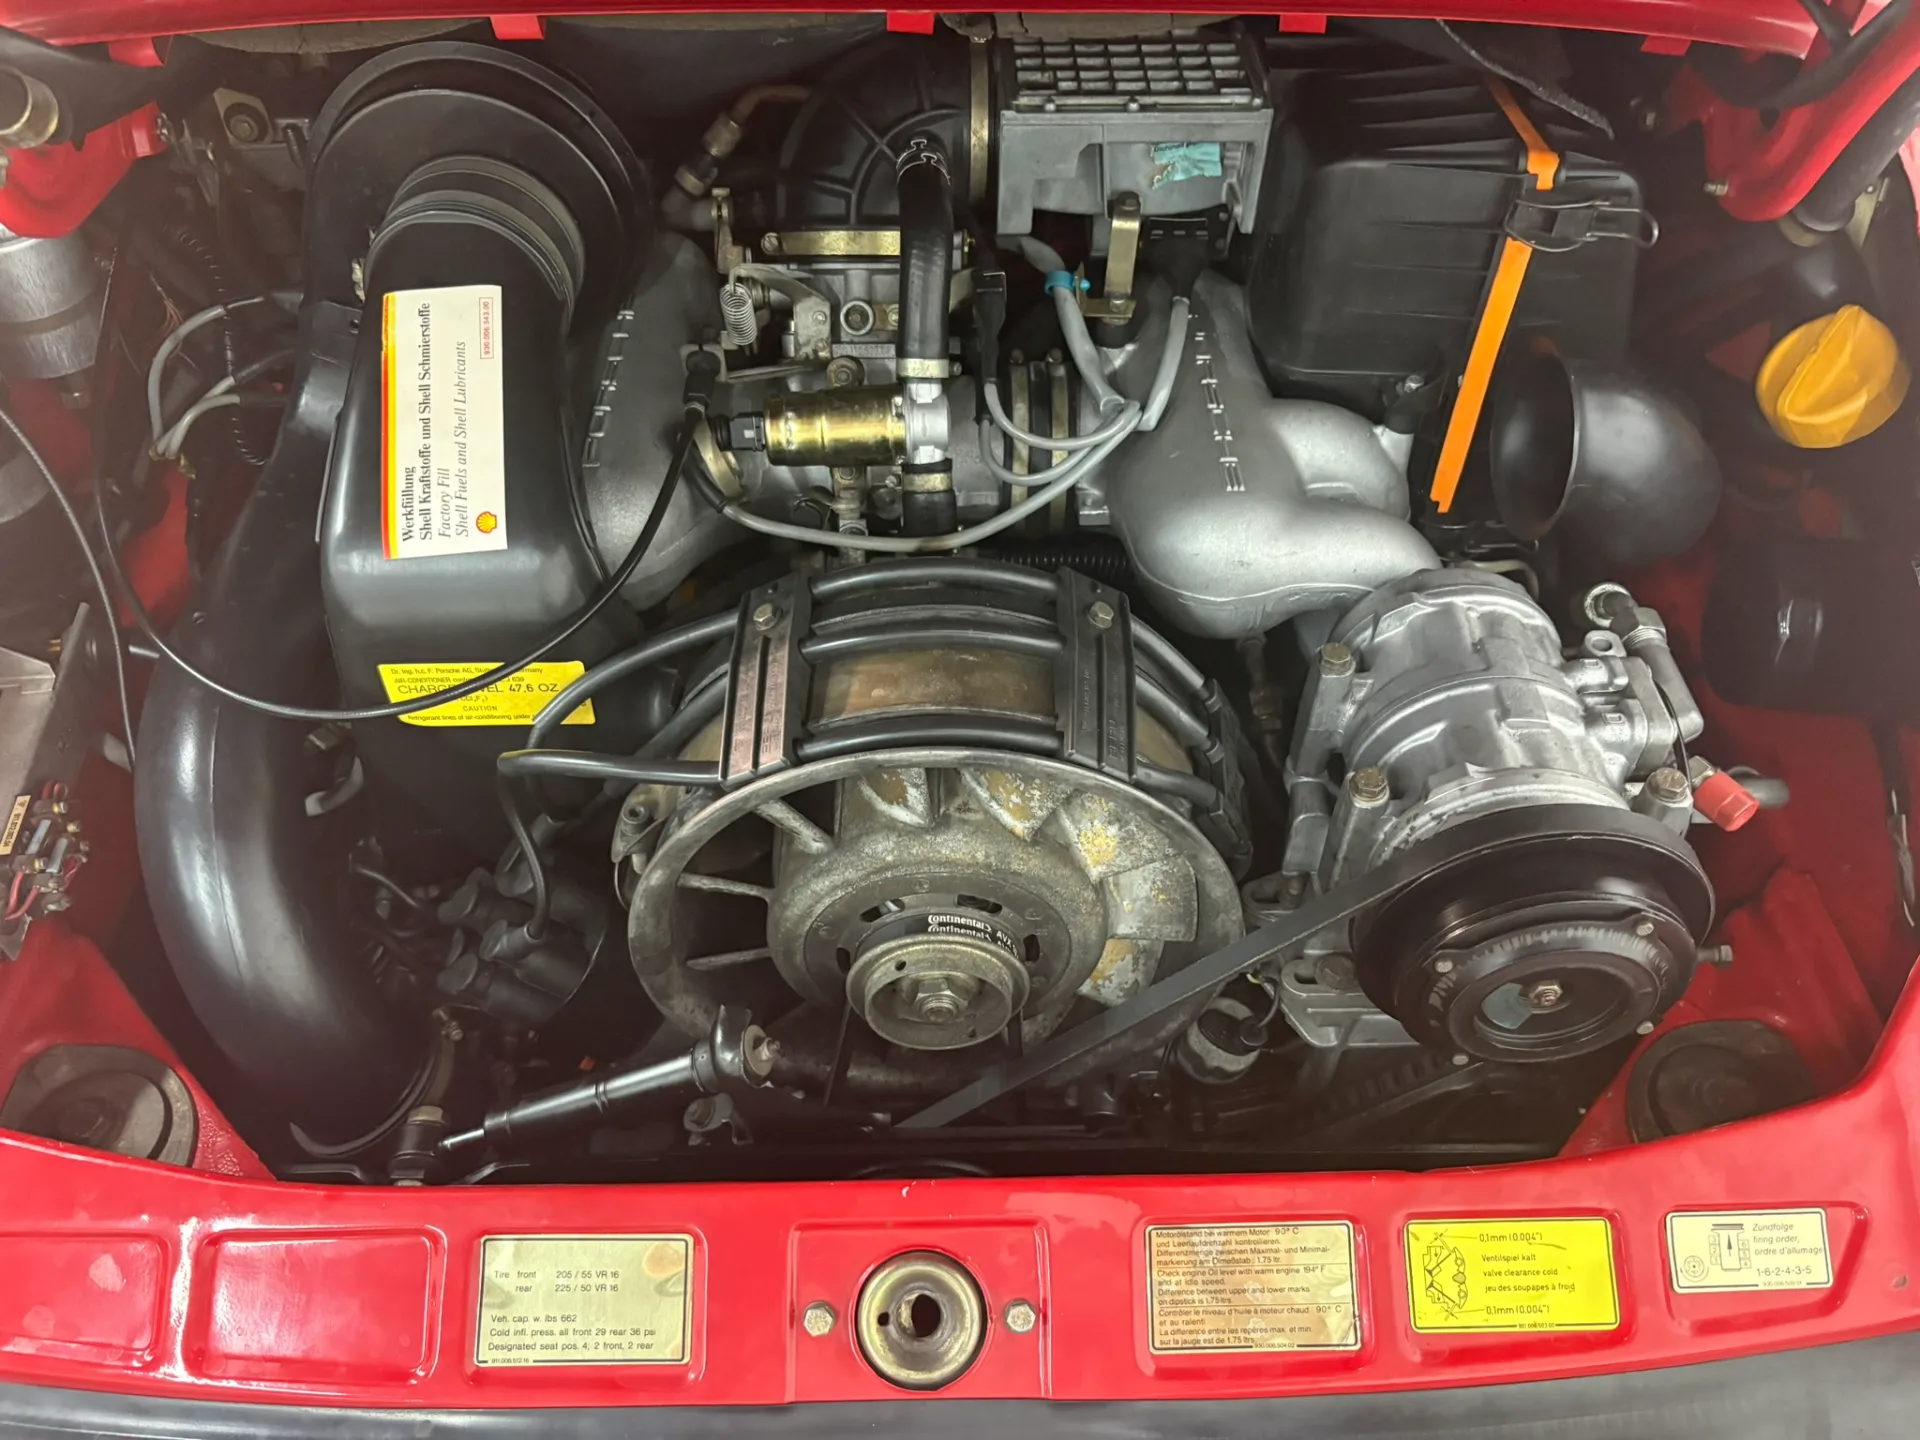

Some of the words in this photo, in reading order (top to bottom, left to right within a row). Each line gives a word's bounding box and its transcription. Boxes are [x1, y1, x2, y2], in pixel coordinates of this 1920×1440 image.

[417, 303, 430, 380] Schmierstoffe
[454, 341, 466, 404] Lubricants
[419, 384, 431, 414] Shell
[455, 408, 466, 438] Shell
[420, 418, 431, 439] und
[455, 442, 467, 465] and
[419, 444, 431, 504] Kraftstoffe
[438, 468, 450, 487] Fill
[455, 469, 467, 500] Fuels
[402, 467, 416, 541] Werkfüllung
[438, 492, 452, 538] Factory
[419, 508, 432, 540] Shell
[455, 505, 468, 537] Shell
[538, 684, 559, 692] OZ
[928, 914, 984, 930] Continental
[1172, 1240, 1232, 1248] Leerlaufdrehzahl
[1754, 1236, 1774, 1244] firing
[1156, 1249, 1213, 1258] Differenzmenge
[1754, 1248, 1777, 1256] ordre
[1156, 1258, 1198, 1268] markierung
[1482, 1254, 1520, 1263] Ventilspiel
[494, 1270, 510, 1278] Tire
[517, 1270, 537, 1278] front
[556, 1270, 572, 1278] 205
[575, 1270, 580, 1278] /
[582, 1270, 592, 1278] 55
[596, 1270, 608, 1278] VR
[1276, 1268, 1300, 1276] engine
[1504, 1268, 1540, 1276] clearance
[1757, 1265, 1812, 1277] 1-6-2-4-3-5
[1158, 1288, 1195, 1296] Difference
[1485, 1286, 1496, 1294] jeu
[1169, 1298, 1196, 1306] dipstick
[1335, 1304, 1342, 1313] C
[491, 1314, 510, 1322] Veh.
[545, 1314, 558, 1322] lbs
[561, 1314, 578, 1322] 662
[490, 1328, 510, 1336] Cold
[514, 1328, 528, 1336] infl.
[531, 1329, 556, 1338] press.
[559, 1328, 568, 1336] all
[572, 1328, 592, 1336] front
[596, 1328, 606, 1336] 29
[630, 1328, 640, 1336] 36
[644, 1328, 656, 1338] psi
[488, 1342, 536, 1352] Designated
[604, 1342, 624, 1350] front,
[628, 1342, 634, 1350] 2
[1181, 1339, 1201, 1347] jauge
